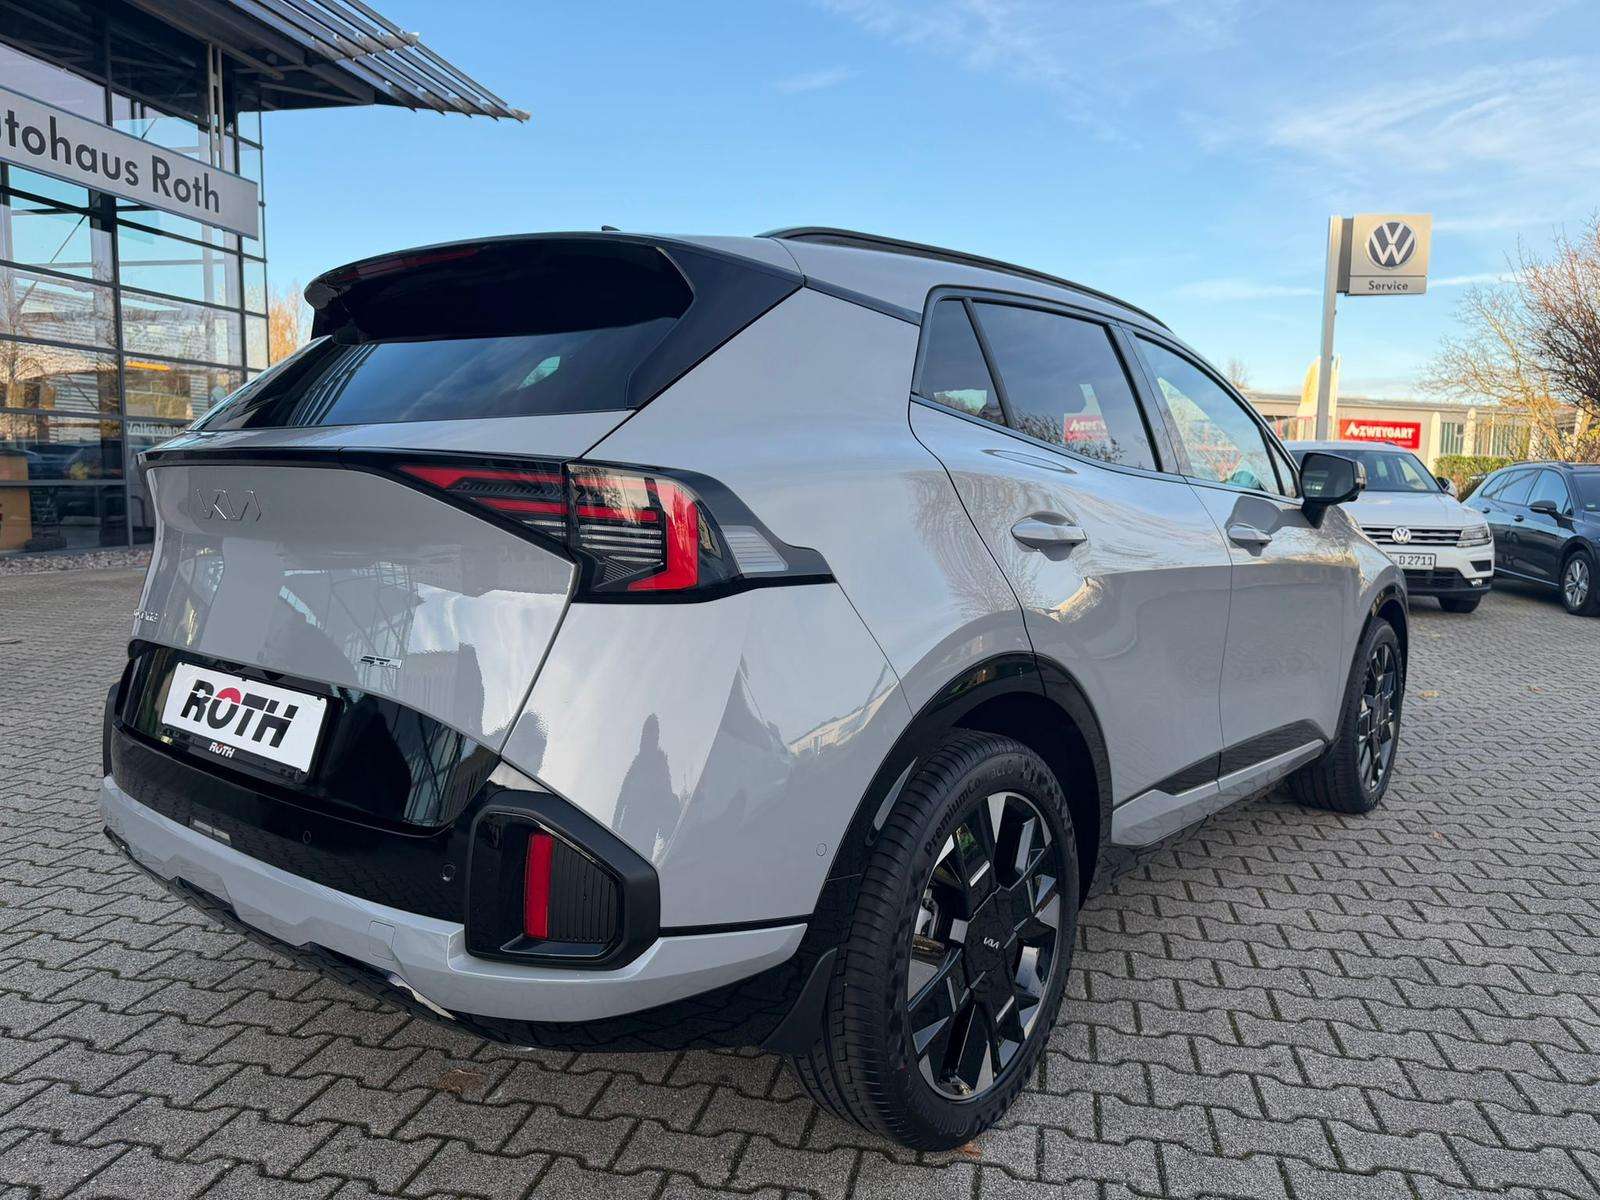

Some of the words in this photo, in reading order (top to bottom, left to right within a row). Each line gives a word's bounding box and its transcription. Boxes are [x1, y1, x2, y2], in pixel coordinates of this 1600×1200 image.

[0, 109, 139, 186] tohaus
[152, 155, 220, 213] Roth
[1368, 280, 1408, 291] Service
[1407, 556, 1433, 566] 2711
[180, 679, 299, 748] ROTH
[209, 741, 236, 759] ROTH
